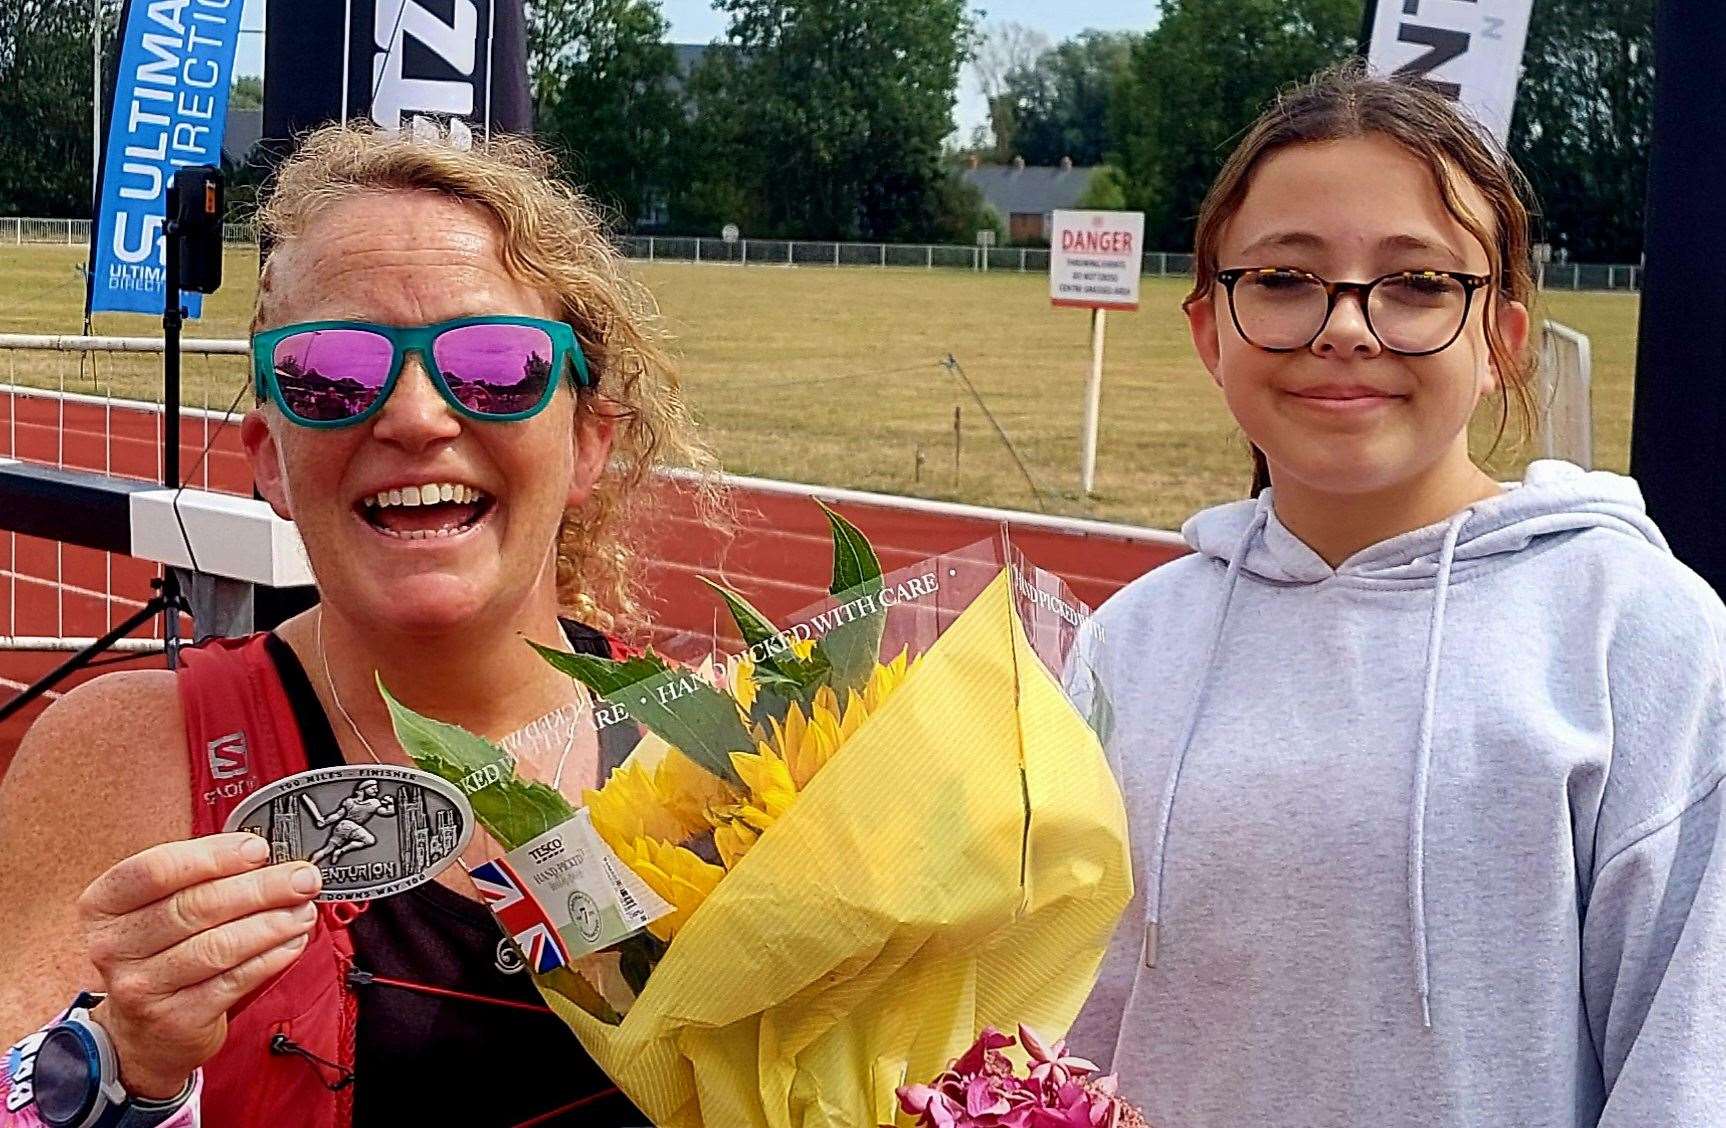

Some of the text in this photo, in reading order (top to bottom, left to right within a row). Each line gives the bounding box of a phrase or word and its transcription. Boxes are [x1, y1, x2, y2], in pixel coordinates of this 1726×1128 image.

[1062, 229, 1133, 252] DANGER
[810, 595, 878, 633] WITH
[878, 572, 940, 608] CARE
[306, 771, 343, 785] MILES
[359, 769, 418, 781] FINISHER
[528, 838, 562, 860] TESCO
[320, 861, 397, 882] ENTURION
[375, 883, 401, 898] WAY
